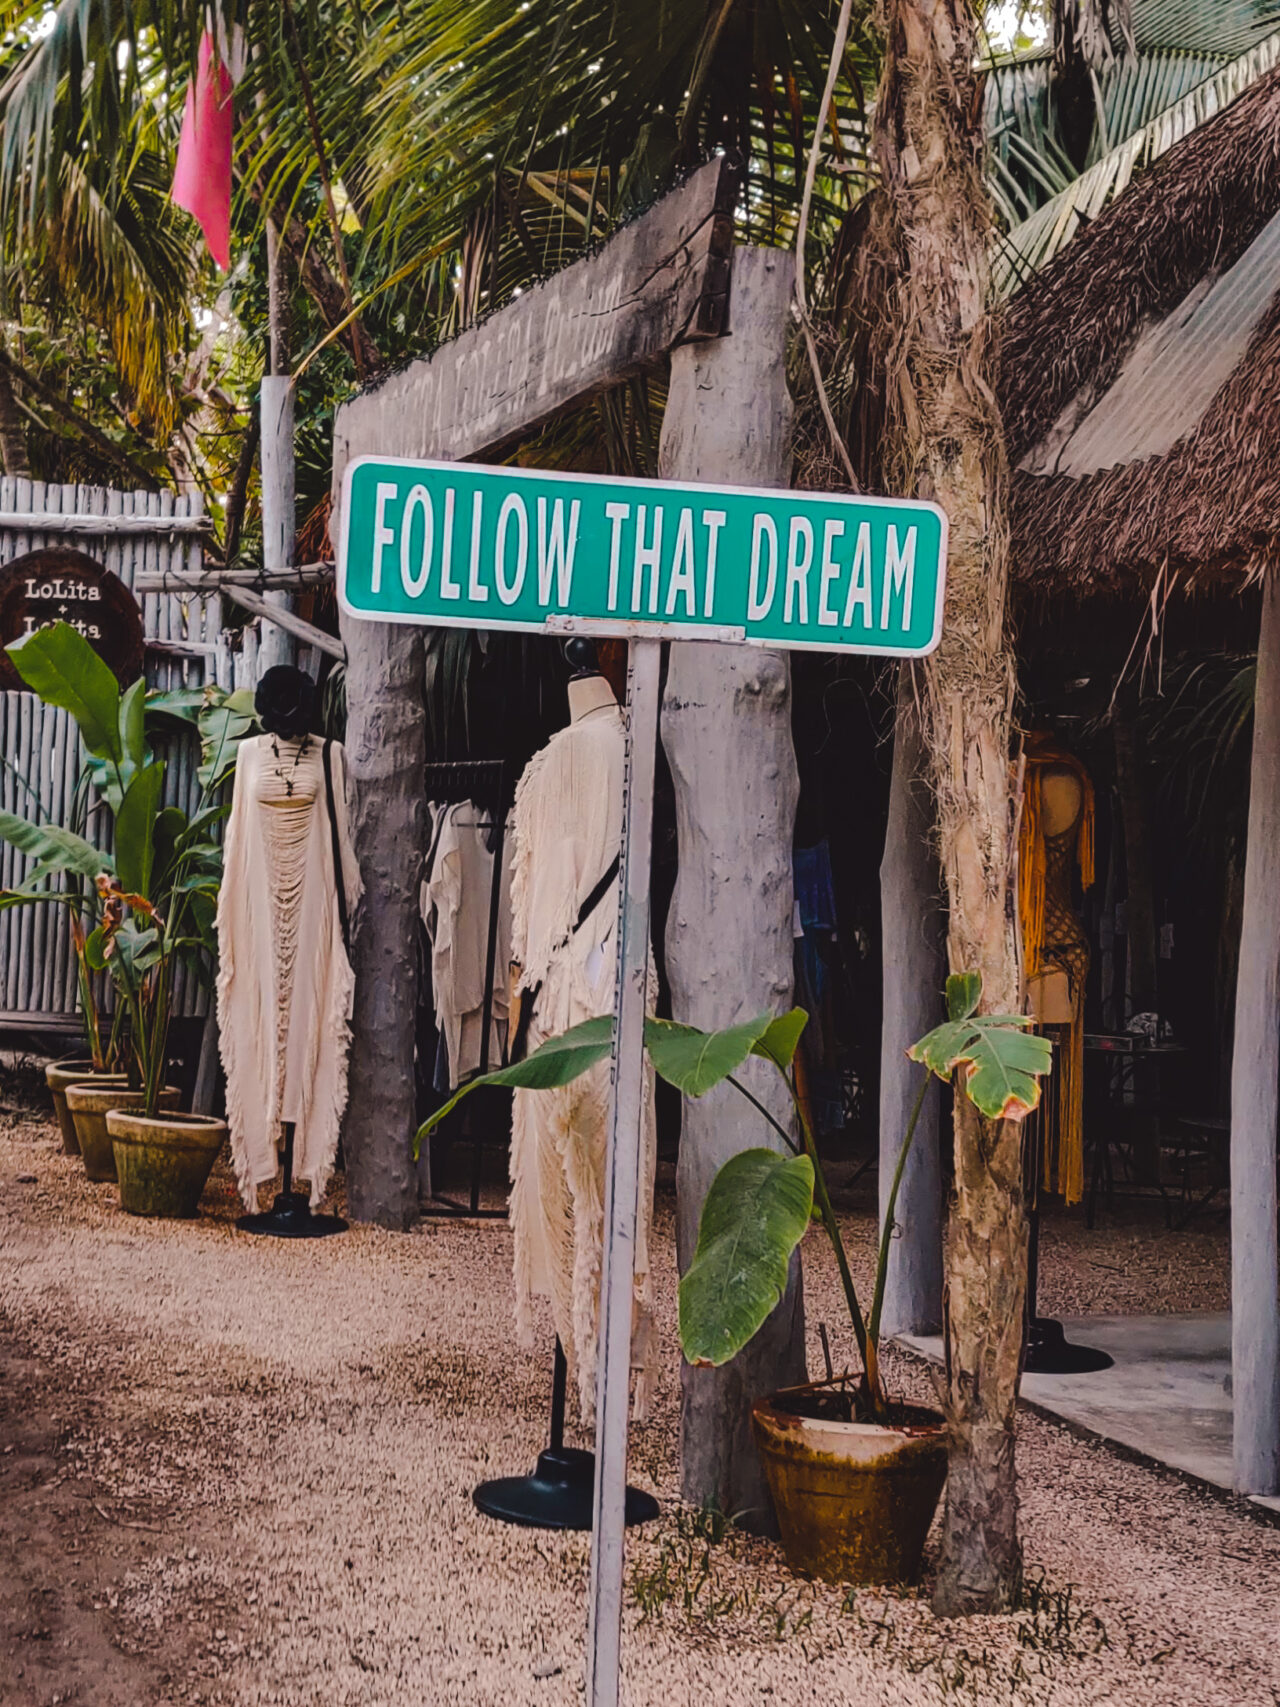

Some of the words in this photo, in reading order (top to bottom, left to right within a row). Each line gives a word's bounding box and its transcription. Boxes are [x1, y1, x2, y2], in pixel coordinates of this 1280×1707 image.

[24, 578, 102, 601] LoLita
[371, 482, 581, 607] FOLLOW
[605, 503, 727, 618] THAT
[747, 513, 918, 631] DREAM
